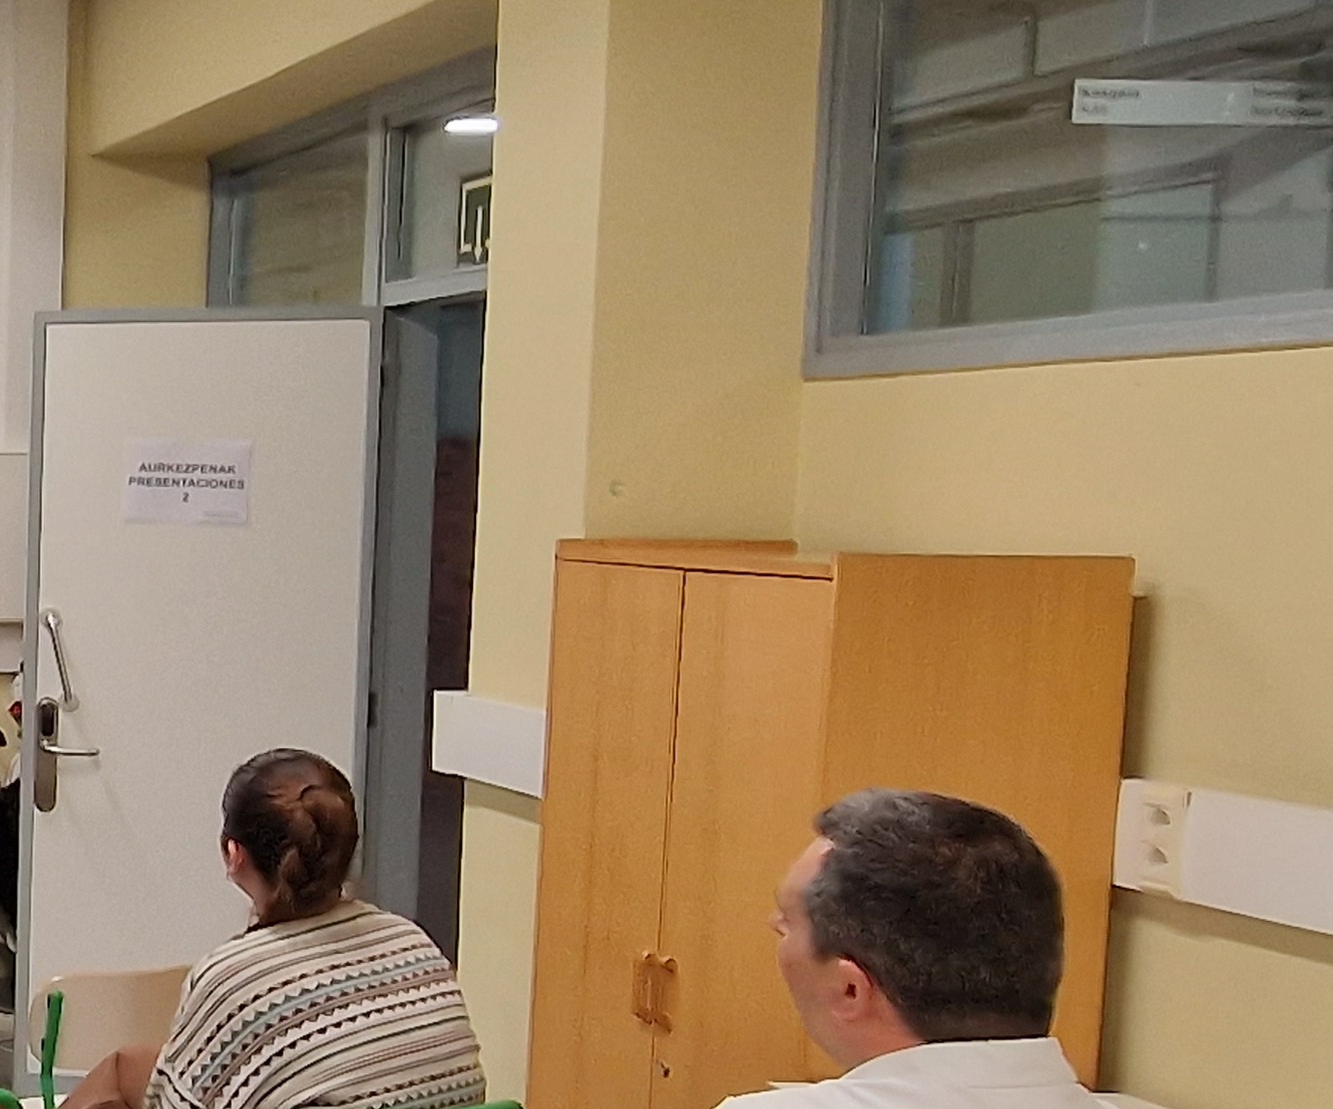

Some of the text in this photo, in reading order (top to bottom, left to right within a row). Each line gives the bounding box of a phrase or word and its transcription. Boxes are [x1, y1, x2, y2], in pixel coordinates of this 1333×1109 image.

[139, 462, 236, 474] AURKEZPENAK
[128, 476, 245, 490] PRESENTACIONES
[182, 492, 190, 503] 2
